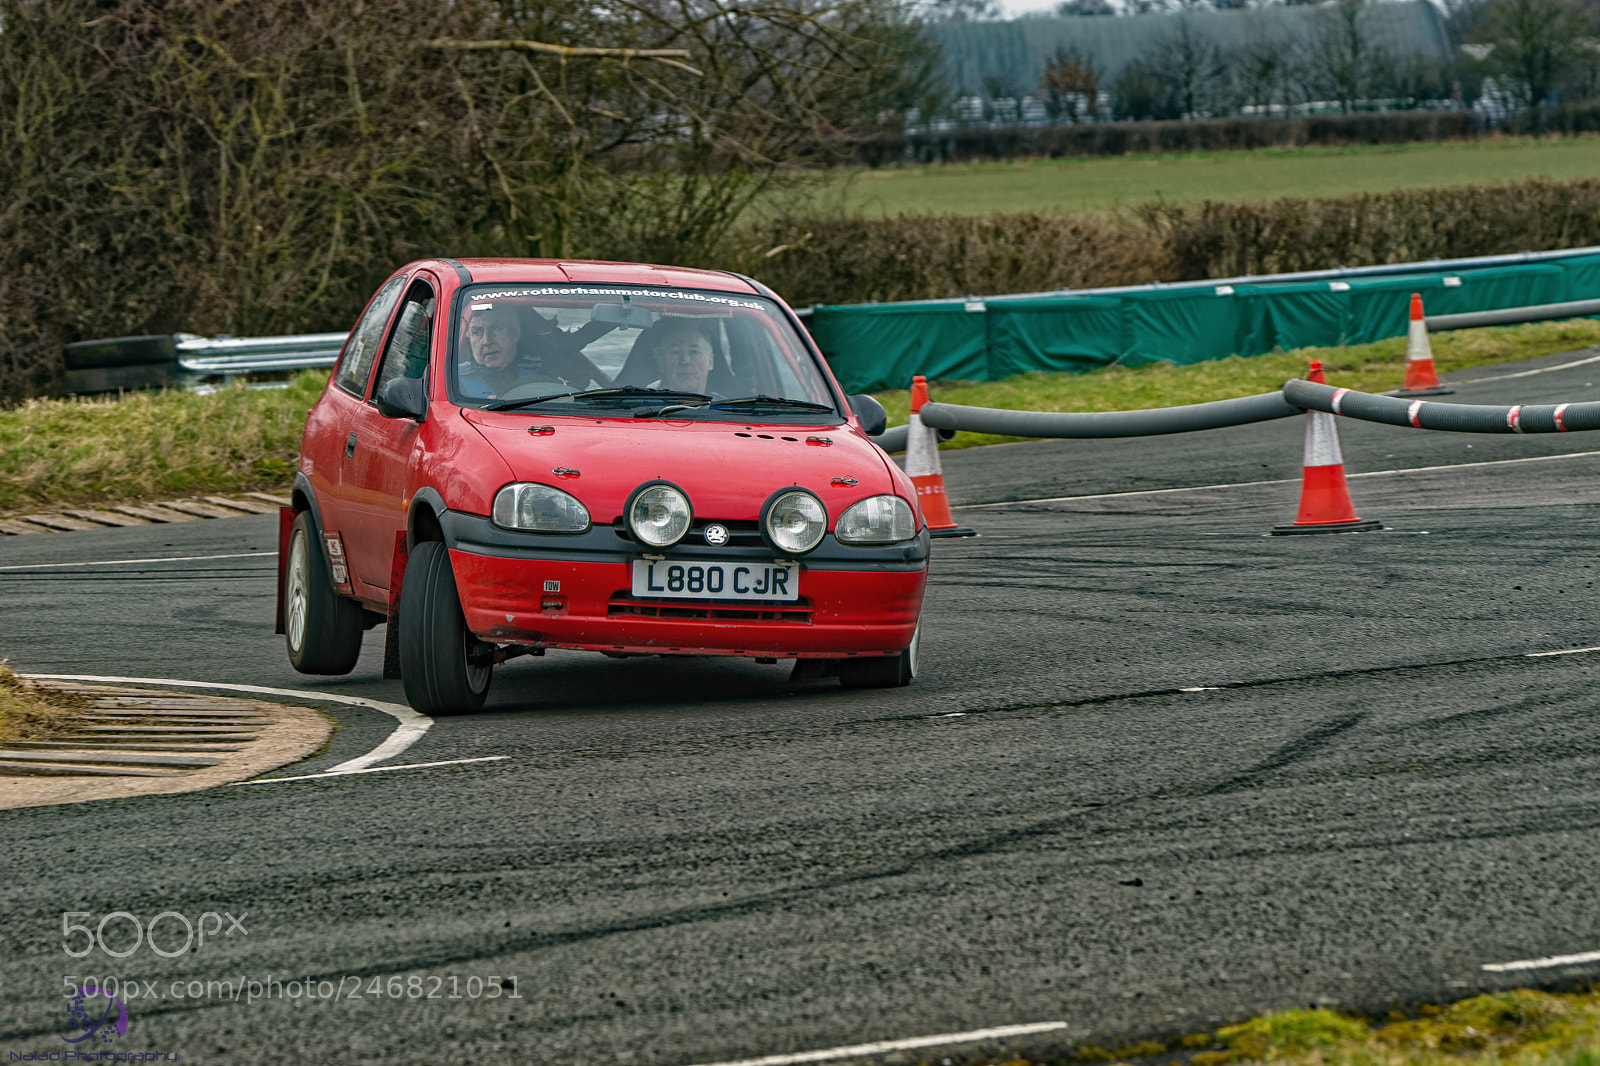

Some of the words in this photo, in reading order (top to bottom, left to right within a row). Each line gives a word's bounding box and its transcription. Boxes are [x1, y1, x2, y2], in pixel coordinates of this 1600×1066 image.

[470, 287, 766, 311] www.rotherhammotorclub.org.uk
[545, 581, 560, 591] TOW
[648, 565, 724, 593] L880
[734, 567, 789, 595] CJR
